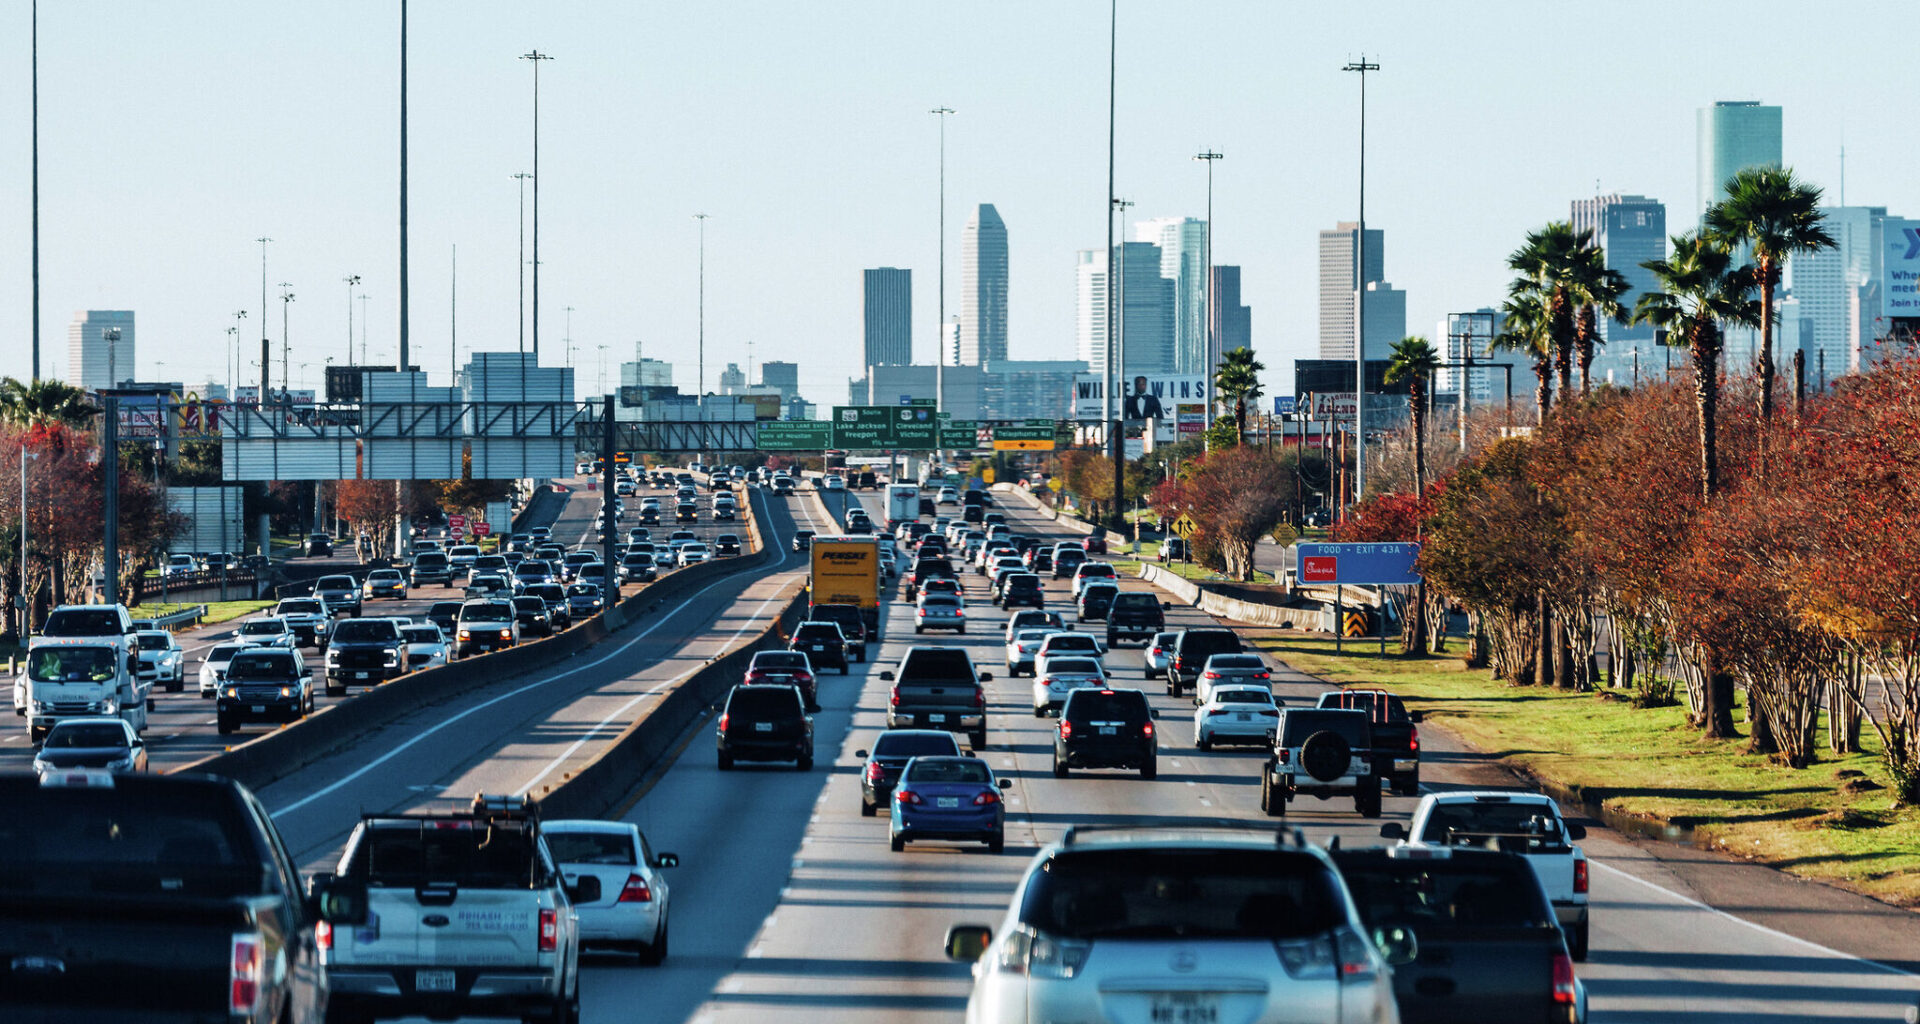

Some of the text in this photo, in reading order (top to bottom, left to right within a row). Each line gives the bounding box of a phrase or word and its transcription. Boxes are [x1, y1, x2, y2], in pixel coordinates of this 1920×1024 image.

[1891, 270, 1920, 280] Whe
[1891, 299, 1911, 307] Join
[1151, 381, 1204, 398] WINS
[1327, 393, 1357, 402] TAQUERI
[1318, 545, 1342, 554] FOOD
[1356, 545, 1375, 554] EXIT
[1381, 545, 1400, 554] 43A
